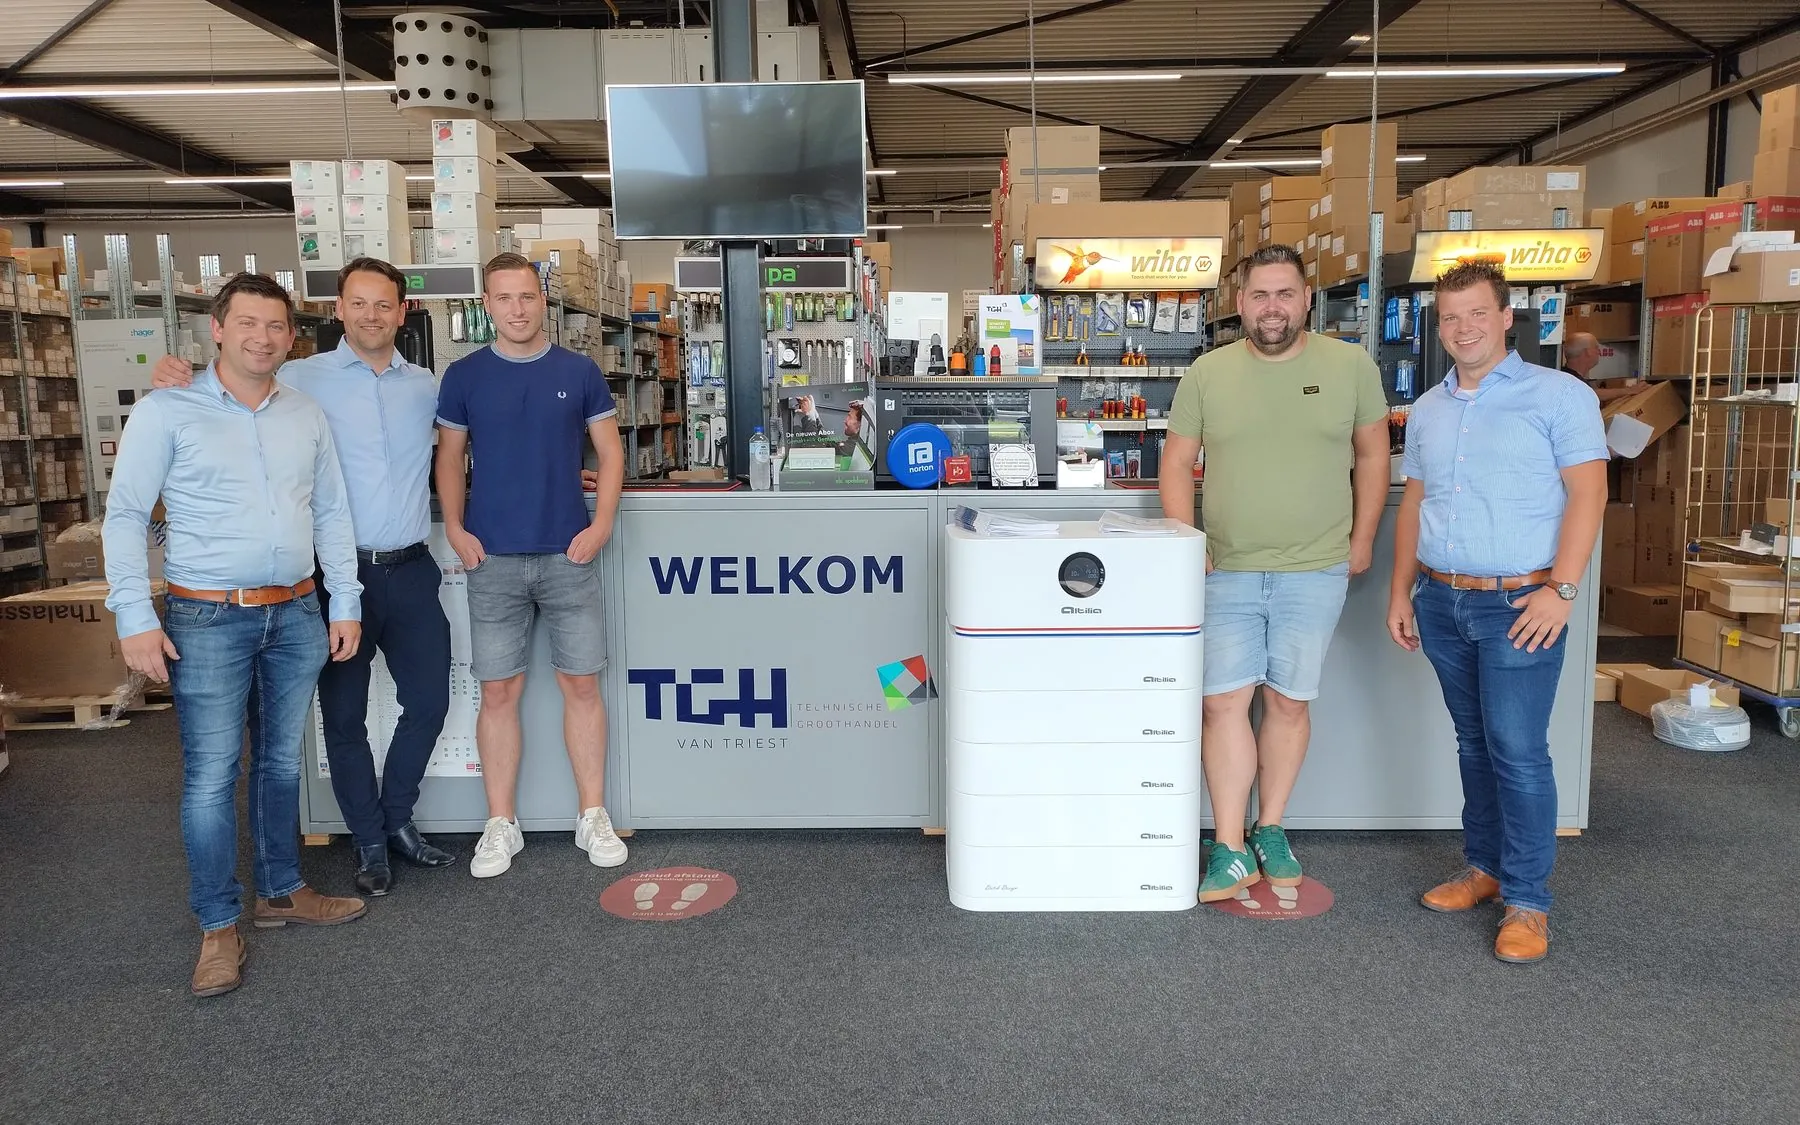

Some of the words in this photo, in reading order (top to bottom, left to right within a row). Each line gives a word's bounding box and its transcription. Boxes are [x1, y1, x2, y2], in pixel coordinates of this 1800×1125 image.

[1651, 201, 1670, 209] ABB
[1709, 212, 1724, 220] ABB
[1687, 219, 1703, 227] ABB
[1511, 240, 1572, 264] wiha
[1131, 249, 1192, 273] wiha
[1593, 304, 1612, 312] ABB
[909, 464, 934, 473] norton
[648, 555, 904, 595] WELKOM
[1652, 598, 1668, 606] ABB
[0, 604, 101, 624] Thalass
[628, 668, 788, 729] TGH
[797, 703, 882, 711] TECHNISCHE
[797, 720, 898, 729] GROOTHANDEL
[676, 738, 714, 749] VAN
[723, 738, 789, 749] TRIEST
